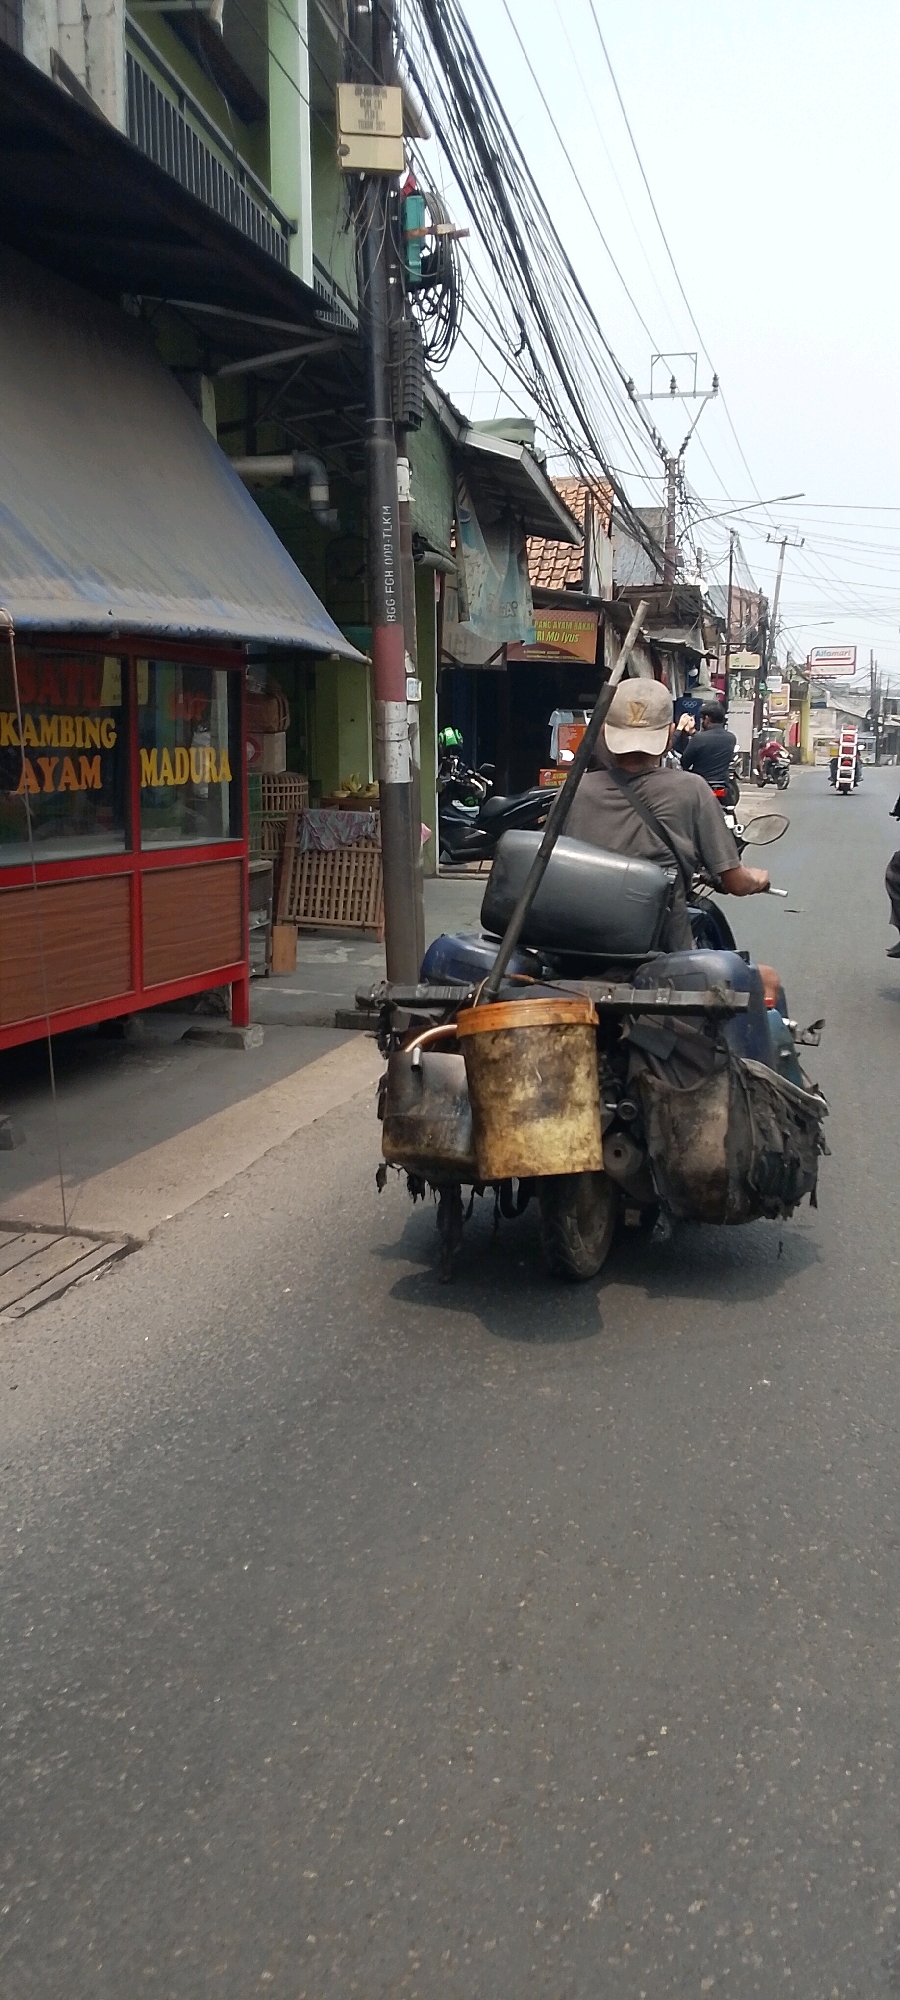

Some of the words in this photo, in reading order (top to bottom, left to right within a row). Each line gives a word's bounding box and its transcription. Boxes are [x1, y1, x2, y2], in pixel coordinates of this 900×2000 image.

[0, 712, 117, 748] KAMBING
[17, 755, 102, 794] AYAM
[140, 747, 232, 787] MADURA
